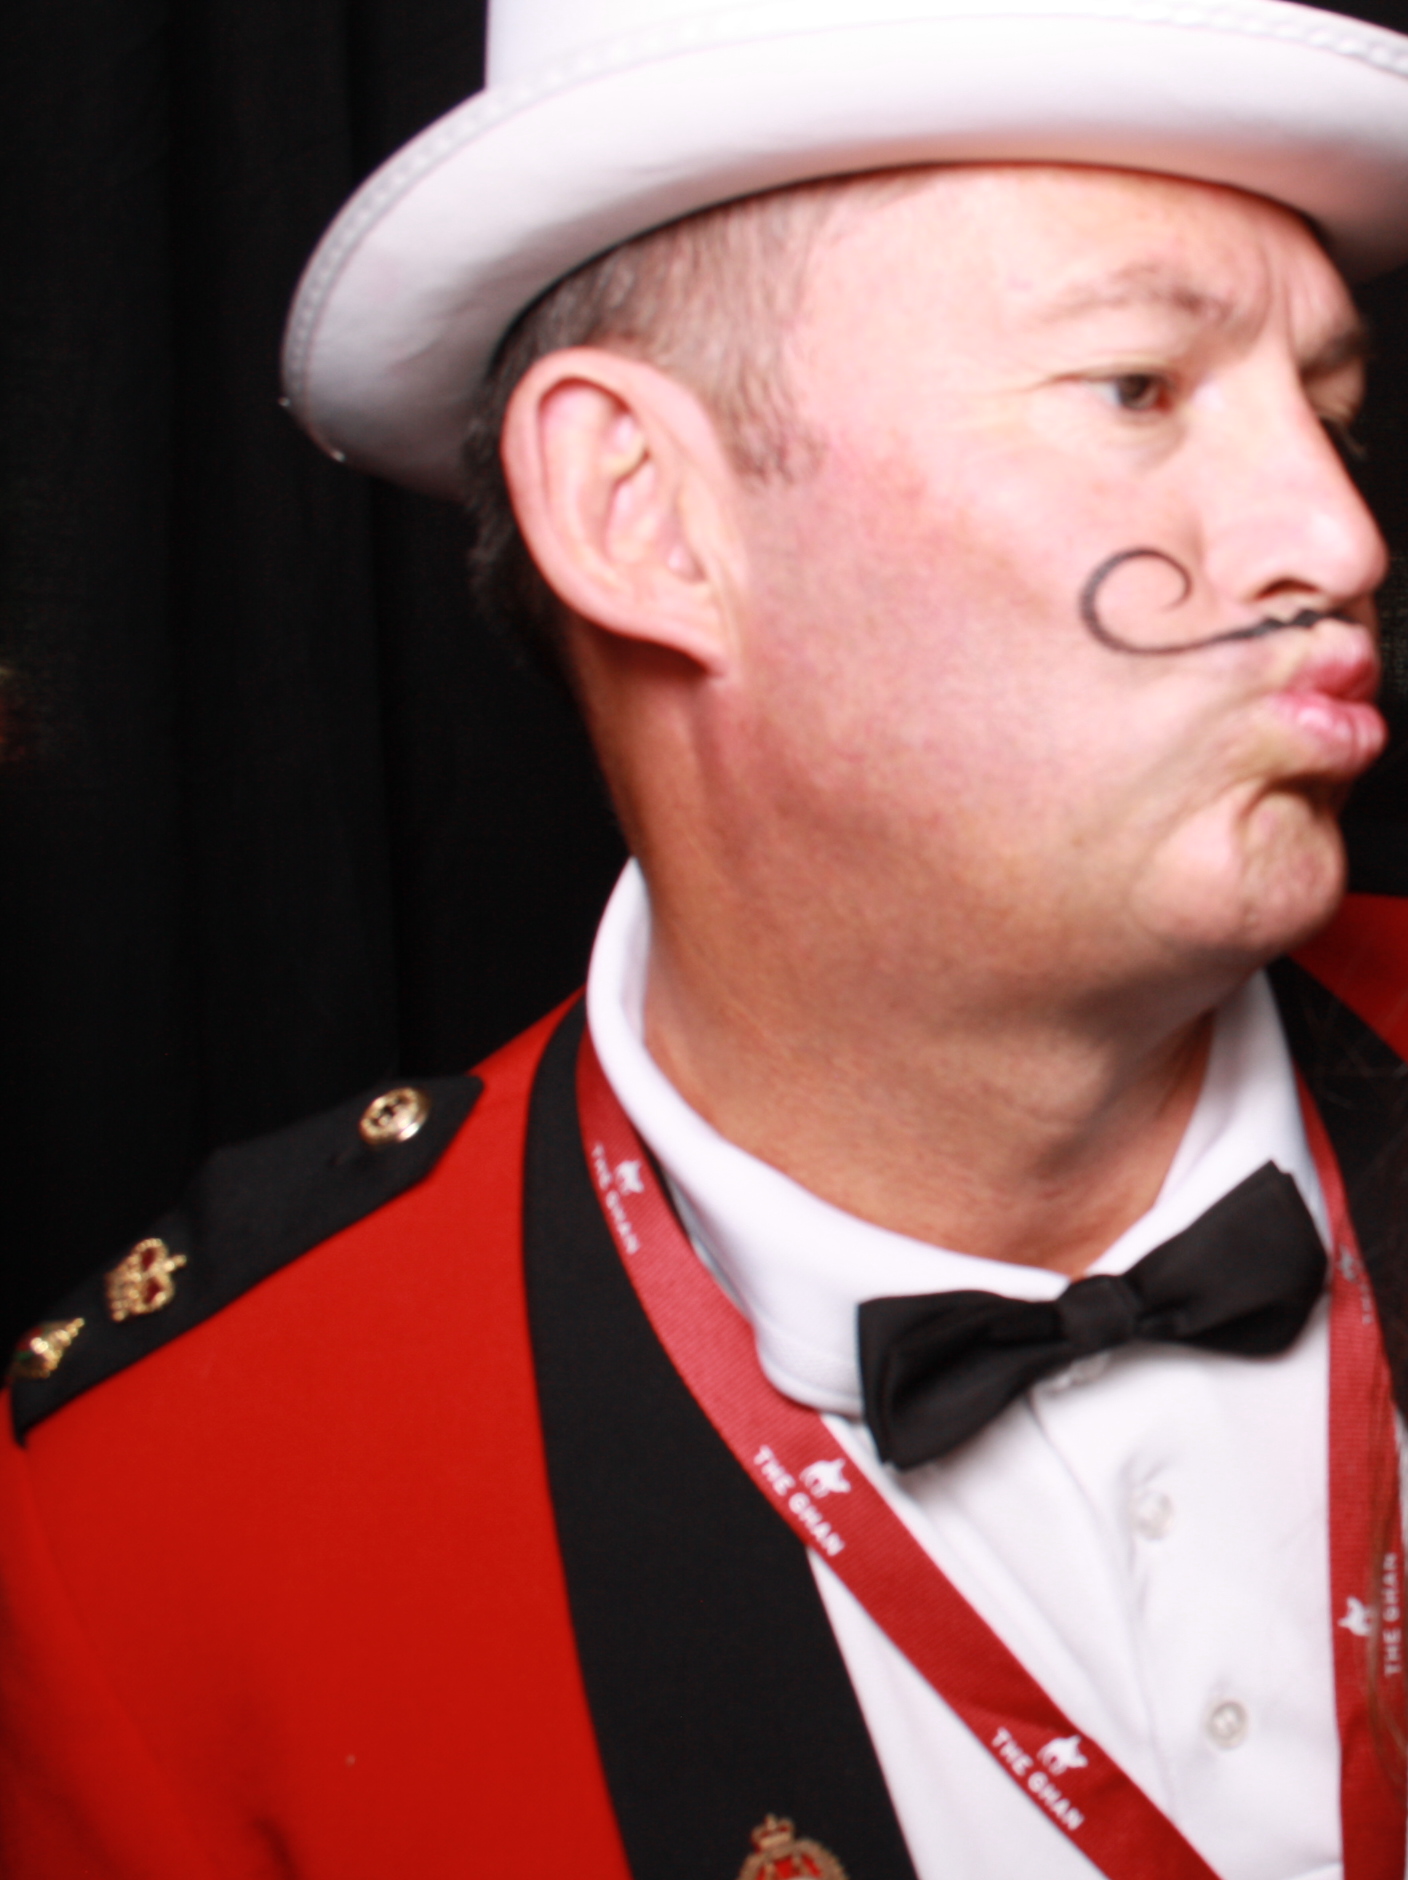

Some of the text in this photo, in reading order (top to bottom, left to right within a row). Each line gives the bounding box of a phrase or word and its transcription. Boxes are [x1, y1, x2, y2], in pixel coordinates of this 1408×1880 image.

[753, 1445, 845, 1556] THE GHAN
[1383, 1628, 1402, 1677] THE
[992, 1726, 1085, 1830] THE GHAN
